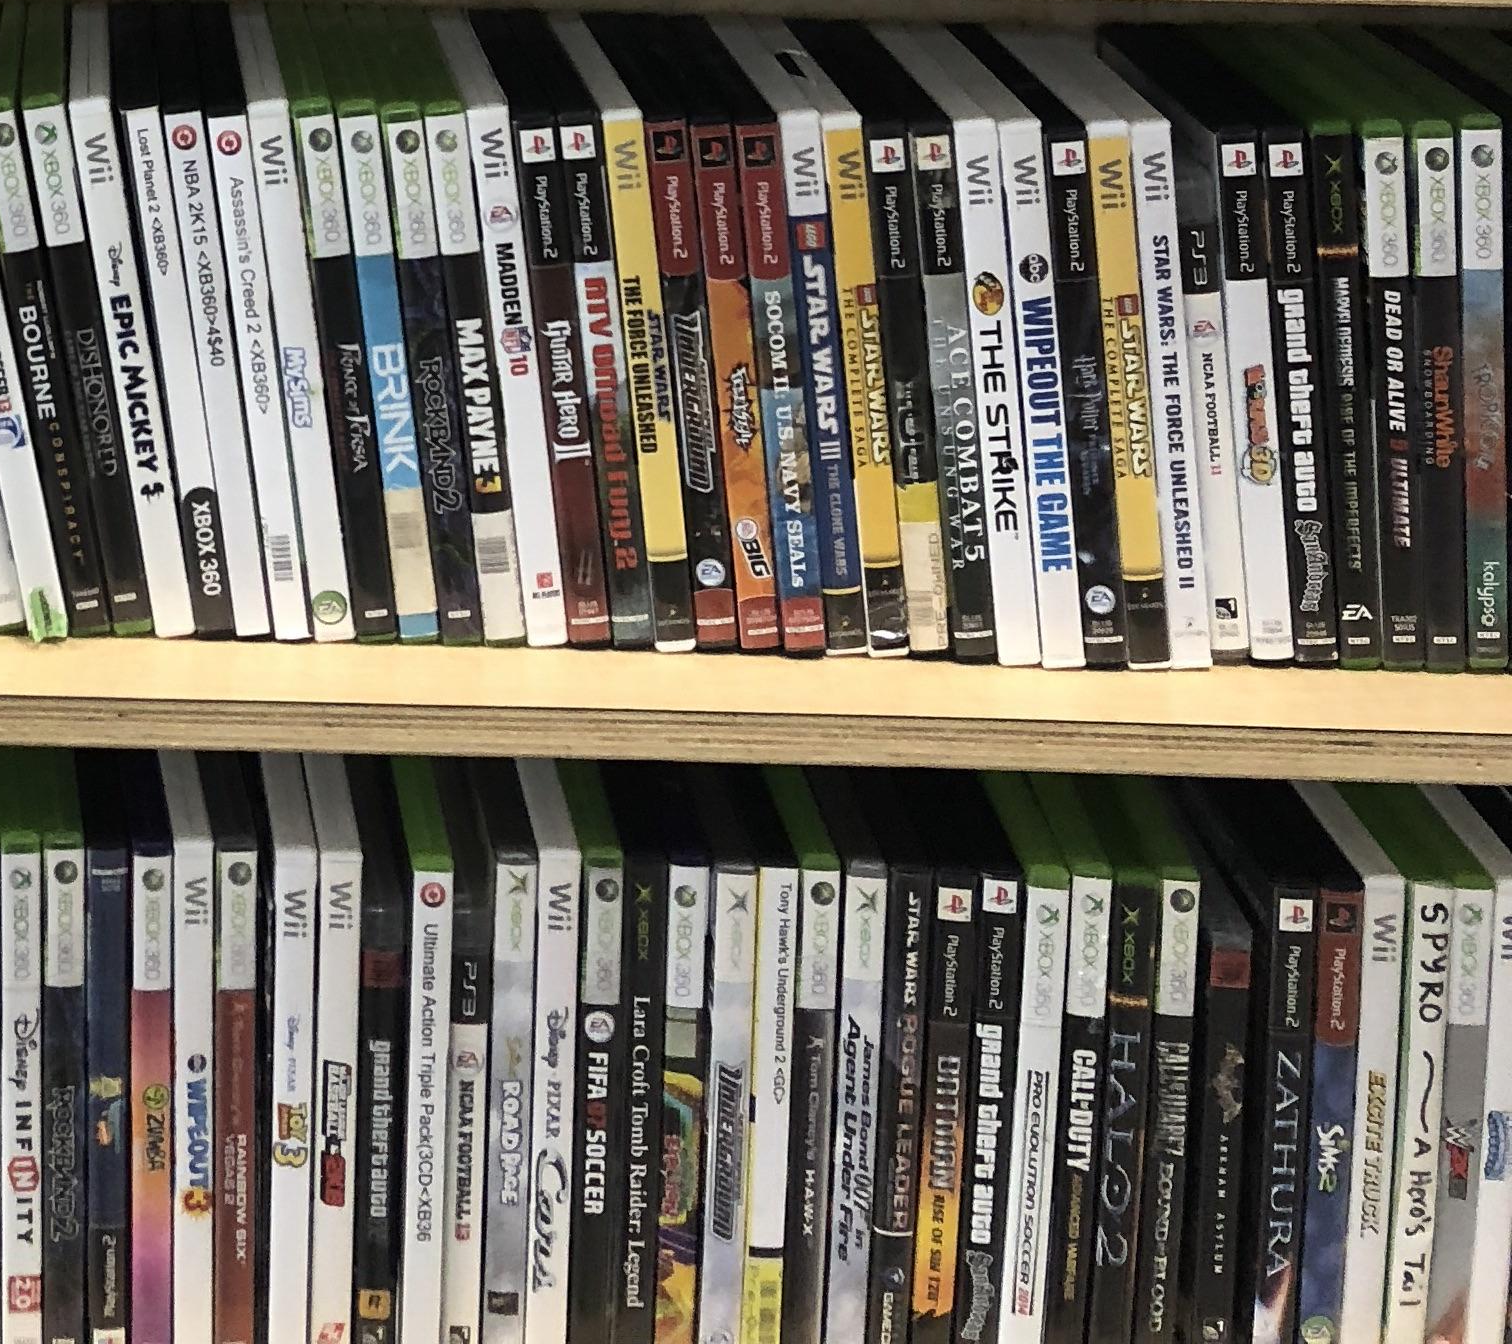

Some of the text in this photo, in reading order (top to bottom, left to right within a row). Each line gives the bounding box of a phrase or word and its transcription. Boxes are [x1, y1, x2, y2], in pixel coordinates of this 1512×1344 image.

[19, 304, 55, 420] BOURNE
[109, 295, 158, 472] EPIC MICKEY
[229, 177, 270, 414] Assassin's Creed 2 <XB360>
[455, 318, 501, 494] MAX PAYNE 3
[495, 243, 528, 376] MADDEN 10
[371, 343, 418, 473] BRINK
[979, 320, 1018, 533] THE STRIKE
[1021, 297, 1072, 572] WIPEOUT THE GAME
[1153, 235, 1194, 590] STAR WARS: THE FORCE UNLEASHED II
[191, 500, 221, 596] XBOX 360
[1476, 561, 1501, 627] kalypso
[416, 924, 438, 1242] Ultimate Action Triple Pack(3CD<XB36
[771, 883, 792, 1104] Tony Hawk's Underground 2 <GC>
[624, 995, 650, 1307] Lara Croft Tomb Raider: Legend
[1097, 1029, 1140, 1266] HALO 2
[1267, 1050, 1301, 1277] ZATHURA
[1400, 903, 1448, 1306] SPYRO A Hero's Tail
